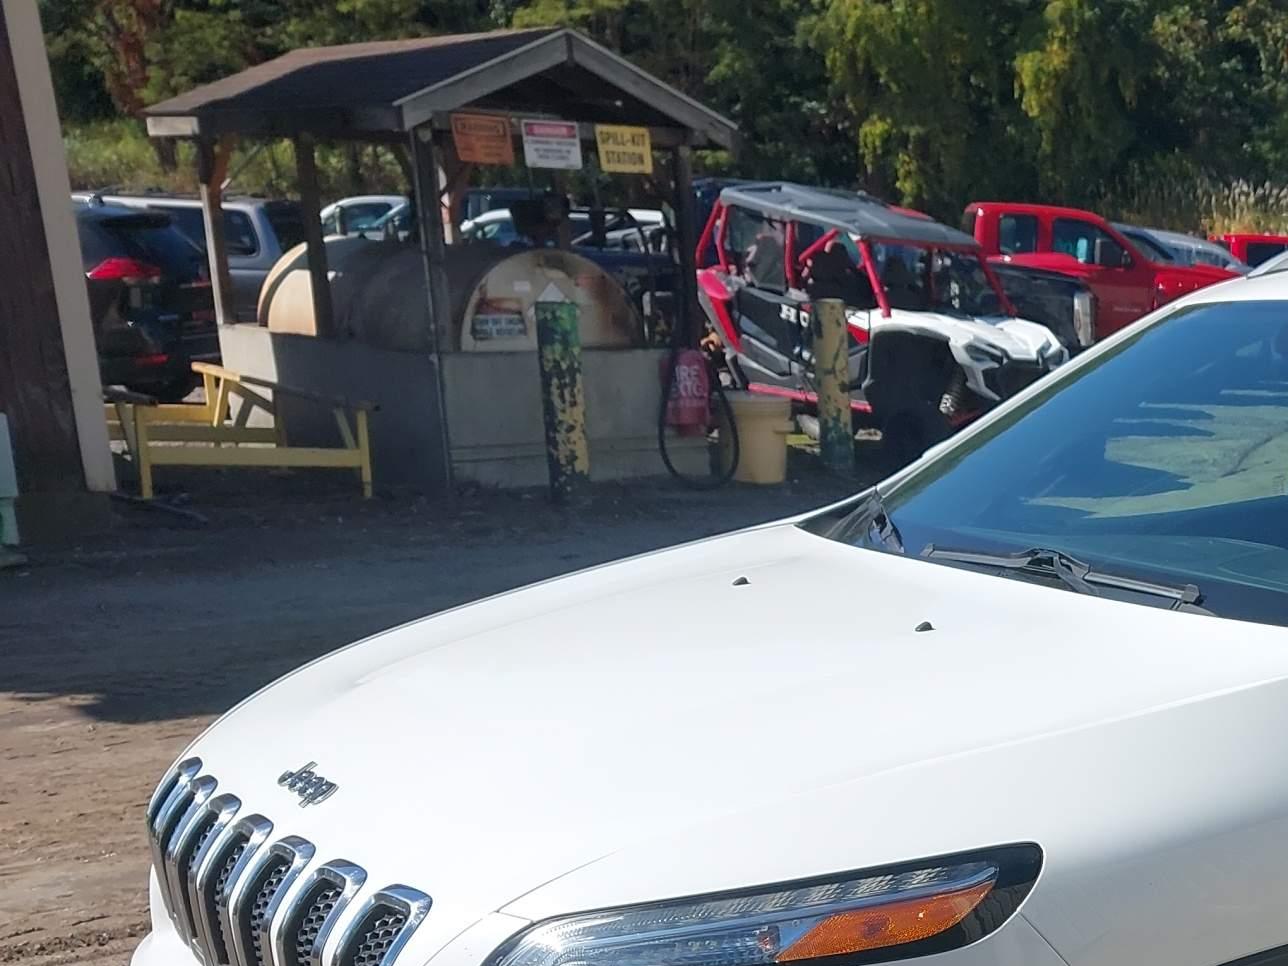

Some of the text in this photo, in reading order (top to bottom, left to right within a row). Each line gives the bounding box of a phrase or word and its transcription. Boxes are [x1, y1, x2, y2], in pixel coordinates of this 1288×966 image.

[600, 130, 645, 146] SPILL-KIT
[605, 150, 645, 165] STATION
[675, 365, 700, 380] IRE
[277, 760, 339, 808] Jeep
